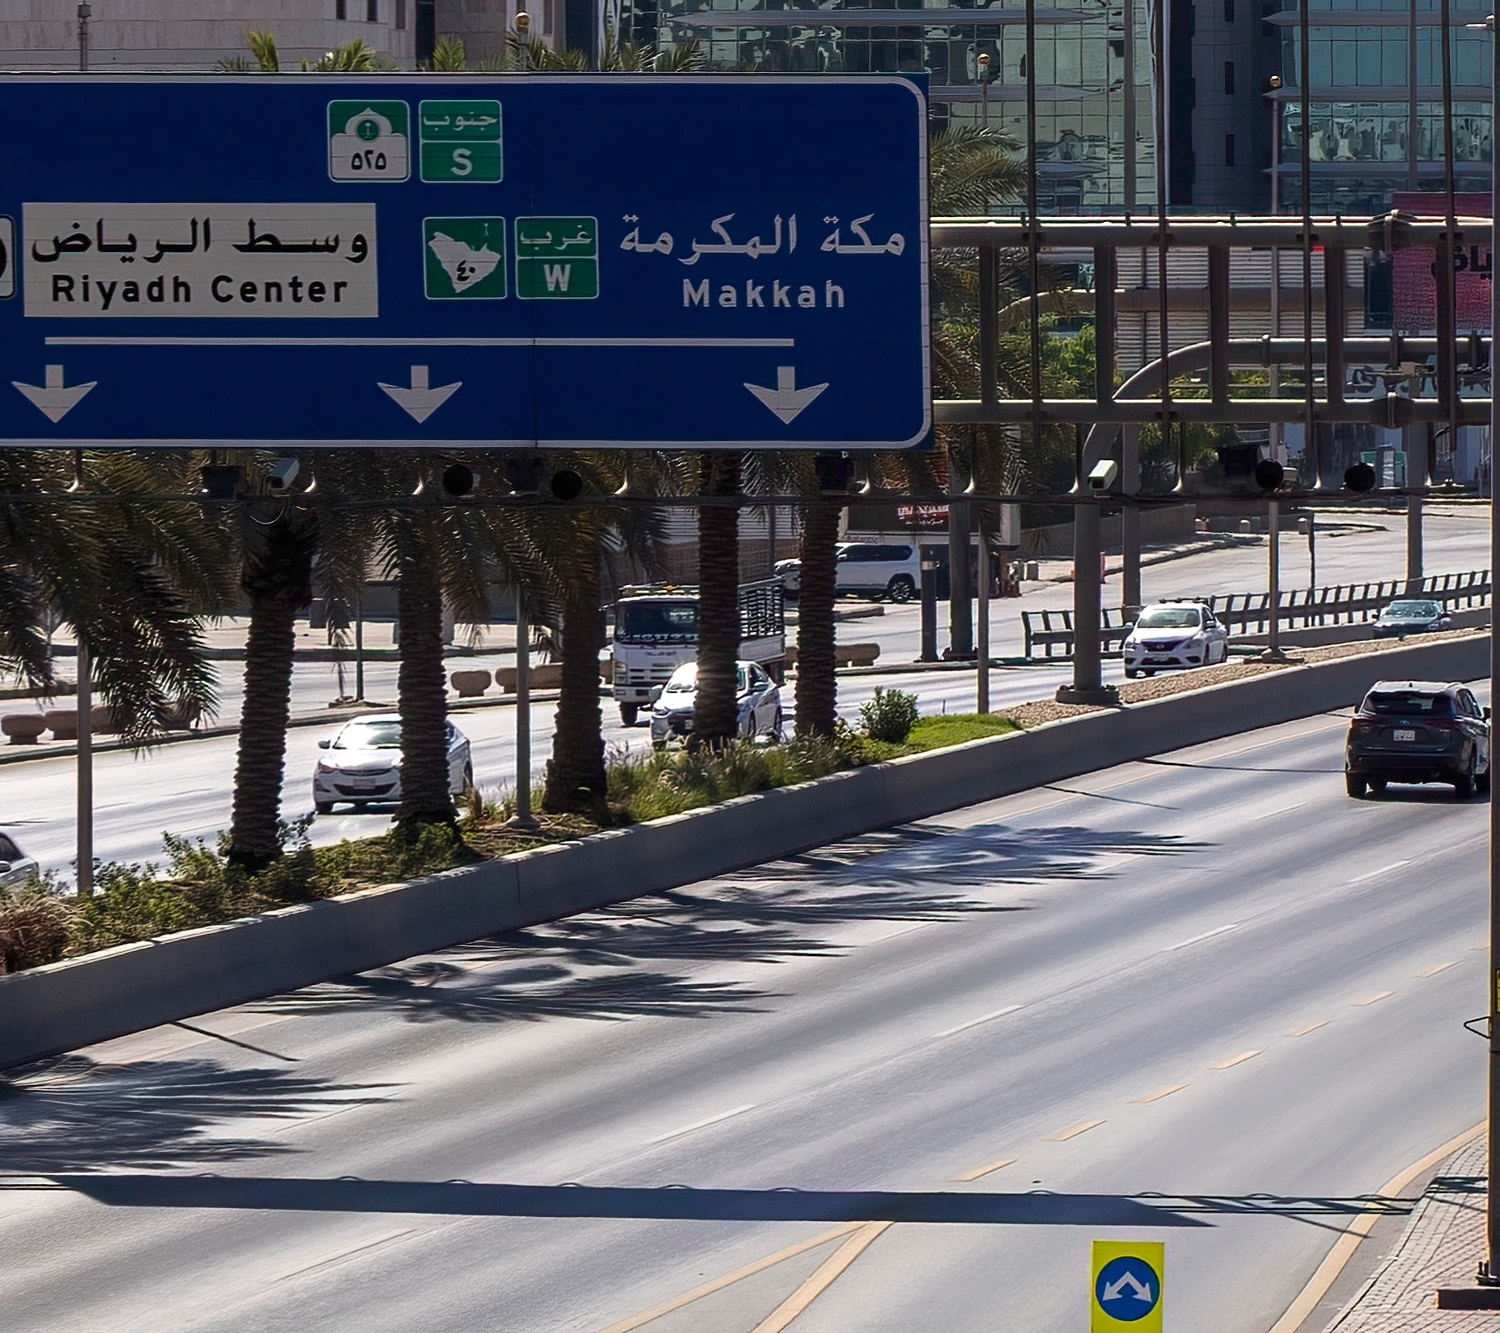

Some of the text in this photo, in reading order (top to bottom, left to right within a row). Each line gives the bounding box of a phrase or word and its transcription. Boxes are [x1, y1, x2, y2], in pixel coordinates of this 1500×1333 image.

[423, 111, 498, 131] جنوب
[351, 149, 387, 171] ٥٢٥
[450, 148, 474, 176] S
[32, 217, 369, 263] وسط الرياض
[519, 223, 593, 250] غرب
[619, 212, 906, 265] مكة المكرمة
[543, 263, 572, 291] W
[52, 274, 348, 310] Riyadh Center
[682, 278, 845, 308] Makkah
